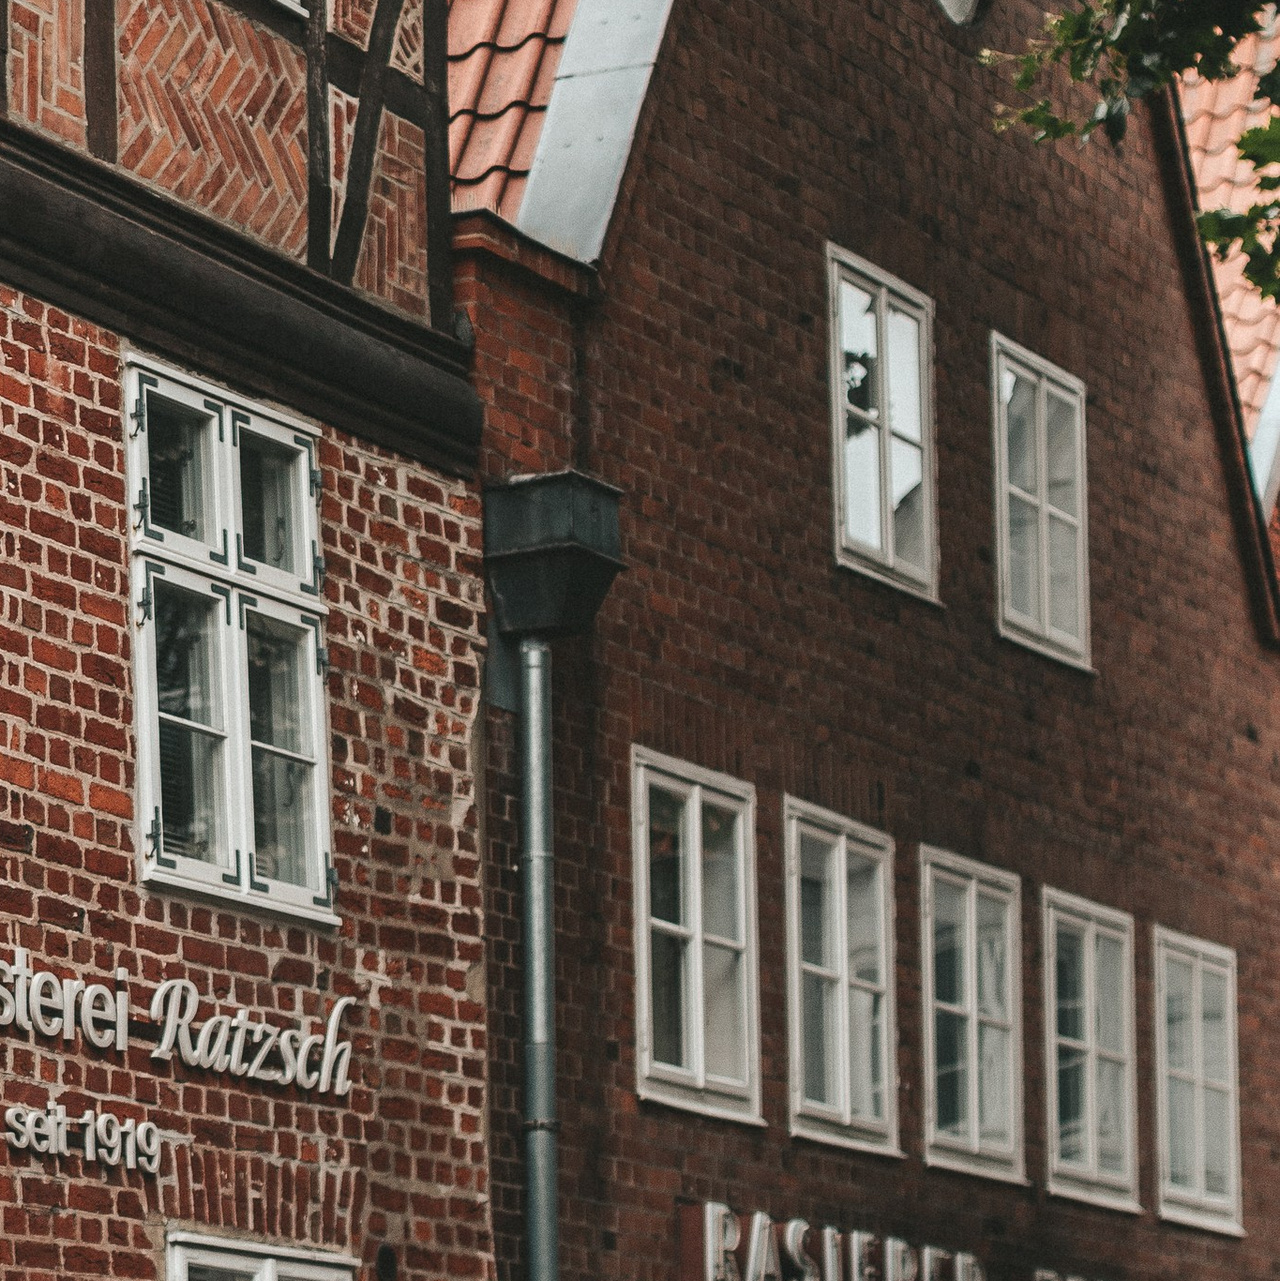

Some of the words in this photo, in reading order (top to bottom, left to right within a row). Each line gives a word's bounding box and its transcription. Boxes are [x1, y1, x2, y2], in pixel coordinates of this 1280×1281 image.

[150, 978, 357, 1096] Ratzsch
[5, 1100, 72, 1157] seit
[80, 1112, 162, 1175] 1919
